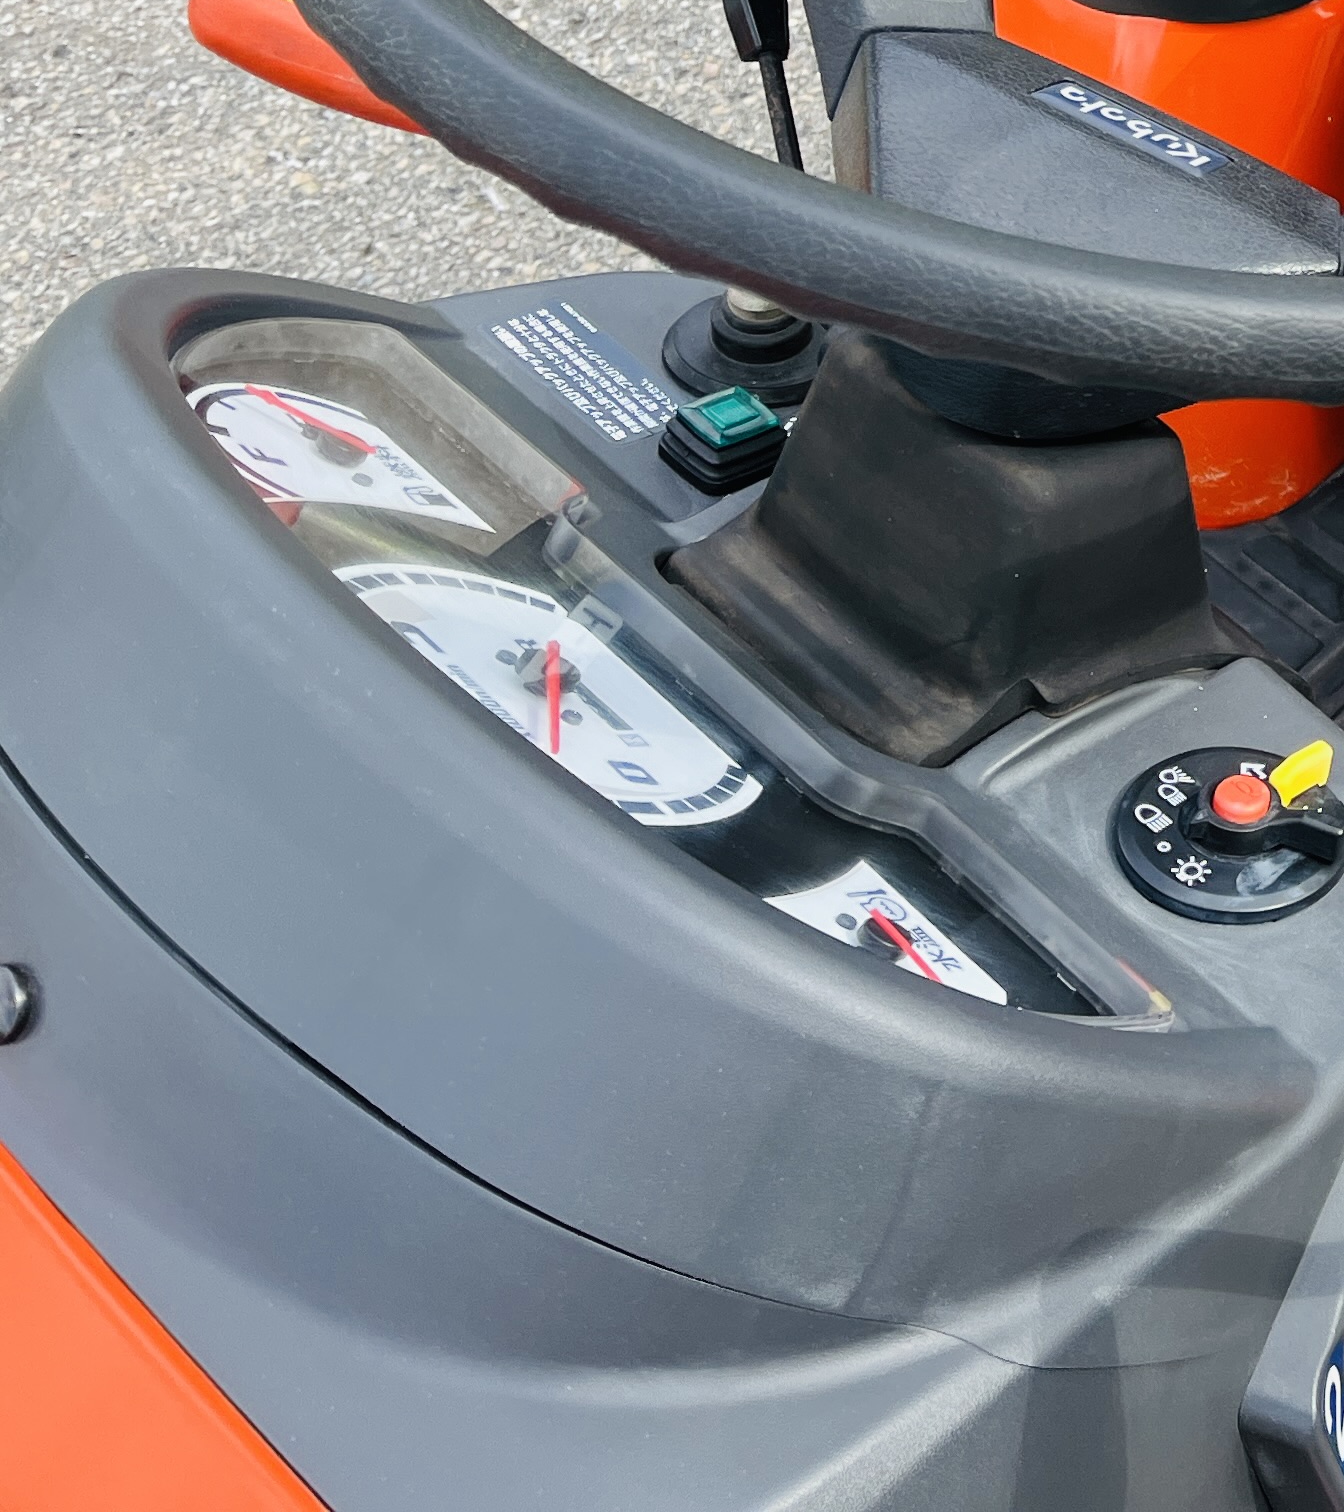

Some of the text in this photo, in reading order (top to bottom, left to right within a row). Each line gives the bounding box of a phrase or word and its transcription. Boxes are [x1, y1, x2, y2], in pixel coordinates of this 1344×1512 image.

[1059, 86, 1211, 167] Kubota
[239, 443, 289, 467] F
[607, 760, 658, 786] 0
[907, 926, 963, 973] 水温
